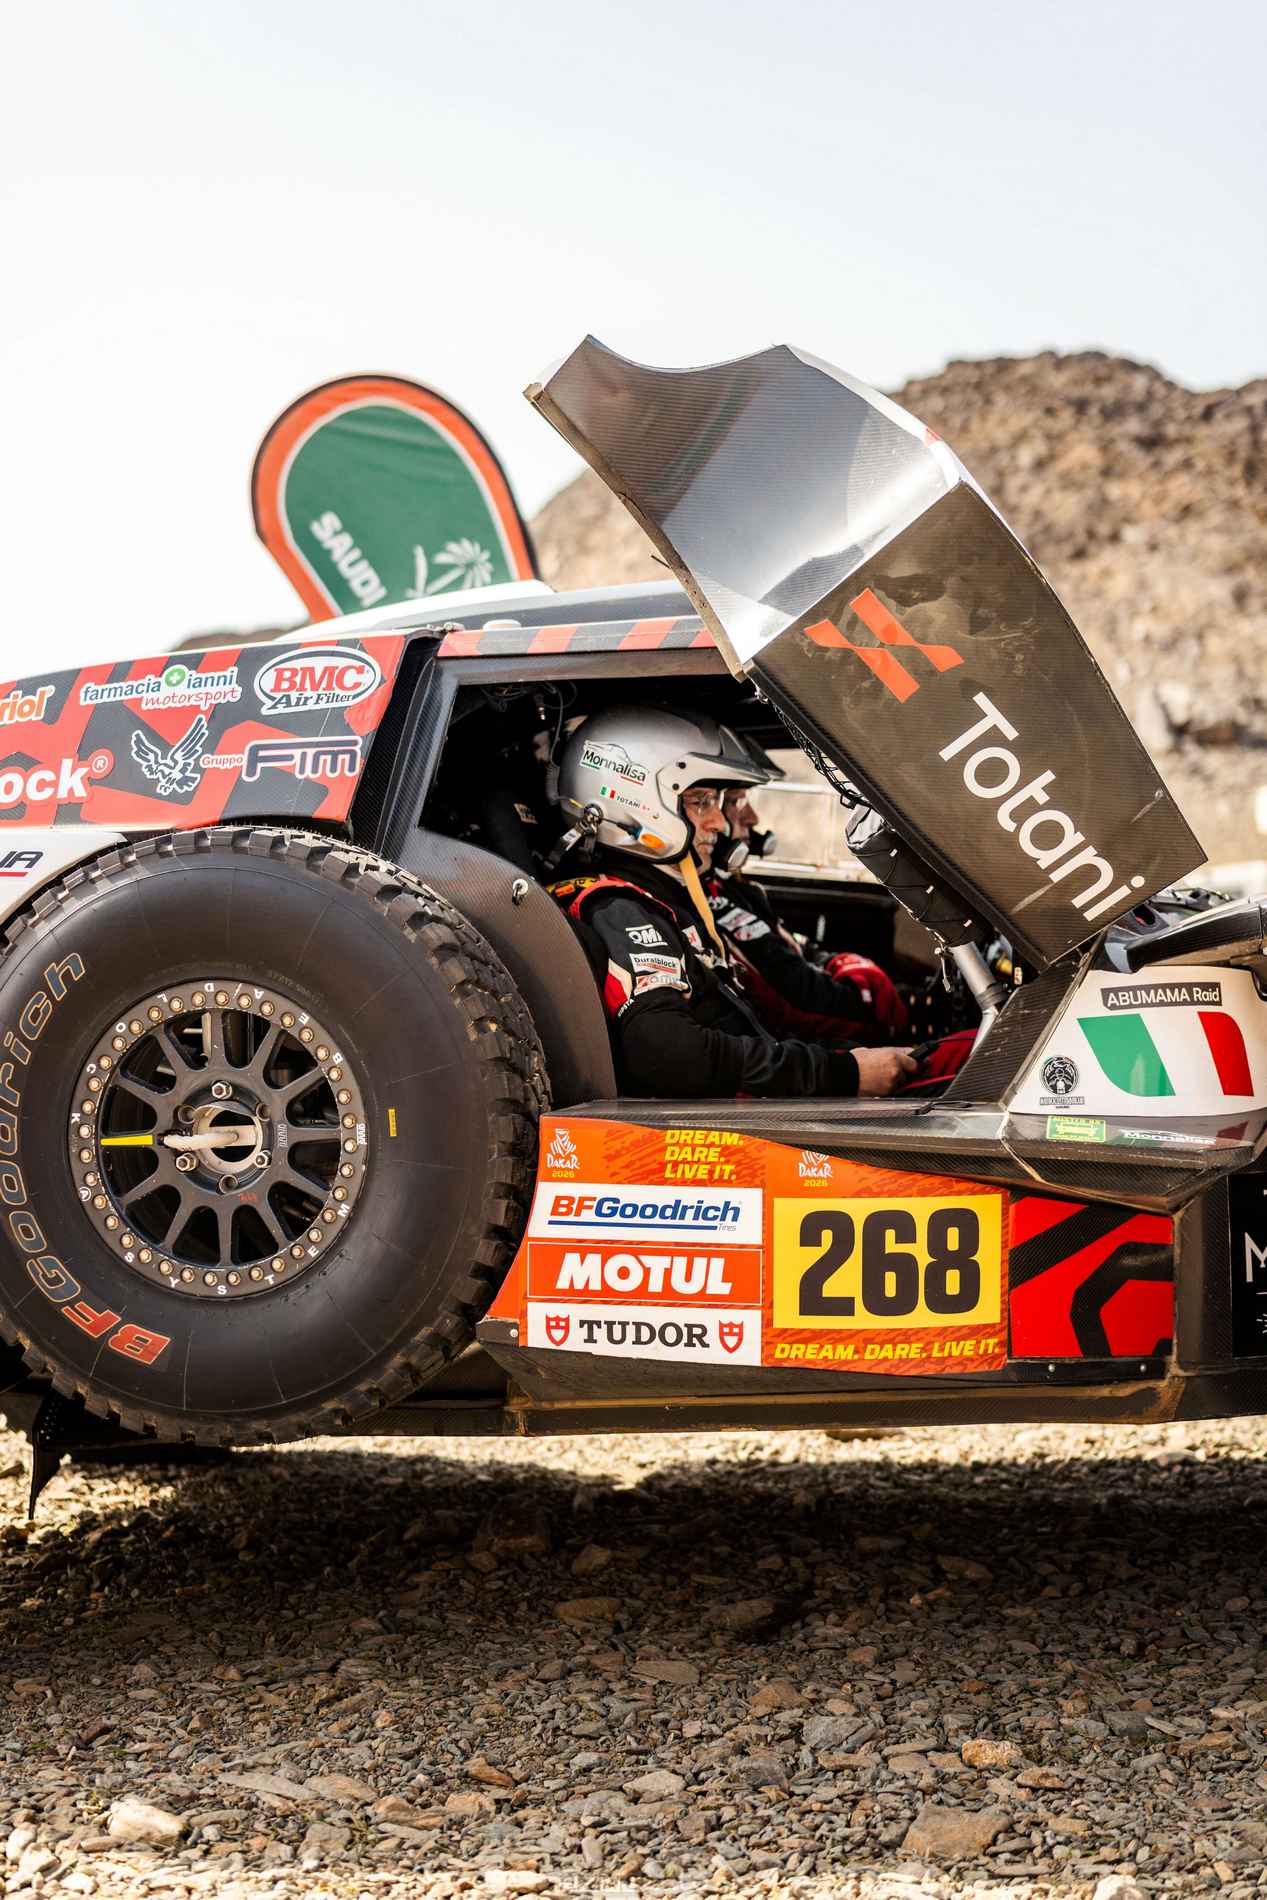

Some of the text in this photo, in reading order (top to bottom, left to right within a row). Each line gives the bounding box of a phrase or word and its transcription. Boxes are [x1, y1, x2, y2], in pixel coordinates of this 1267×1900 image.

[309, 511, 387, 608] SAUDI
[83, 670, 235, 702] farmacia ianni
[270, 665, 365, 693] BMC
[144, 688, 238, 707] motorsport
[268, 693, 352, 710] Air Filter
[202, 755, 244, 767] Gruppo
[583, 750, 647, 781] Monnalisa
[938, 691, 1145, 922] Totani
[1107, 987, 1220, 1007] ABUMAMA Raid
[664, 1130, 744, 1146] DREAM.
[664, 1147, 725, 1162] DARE.
[664, 1164, 737, 1180] LIVE IT.
[798, 1163, 833, 1178] DAKAR
[550, 1195, 741, 1222] BFGoodrich
[717, 1223, 737, 1232] Tires
[555, 1252, 733, 1295] MOTUL
[798, 1207, 981, 1317] 268
[579, 1319, 711, 1348] TUDOR
[774, 1338, 1000, 1361] DREAM. DARE. LIVE IT.
